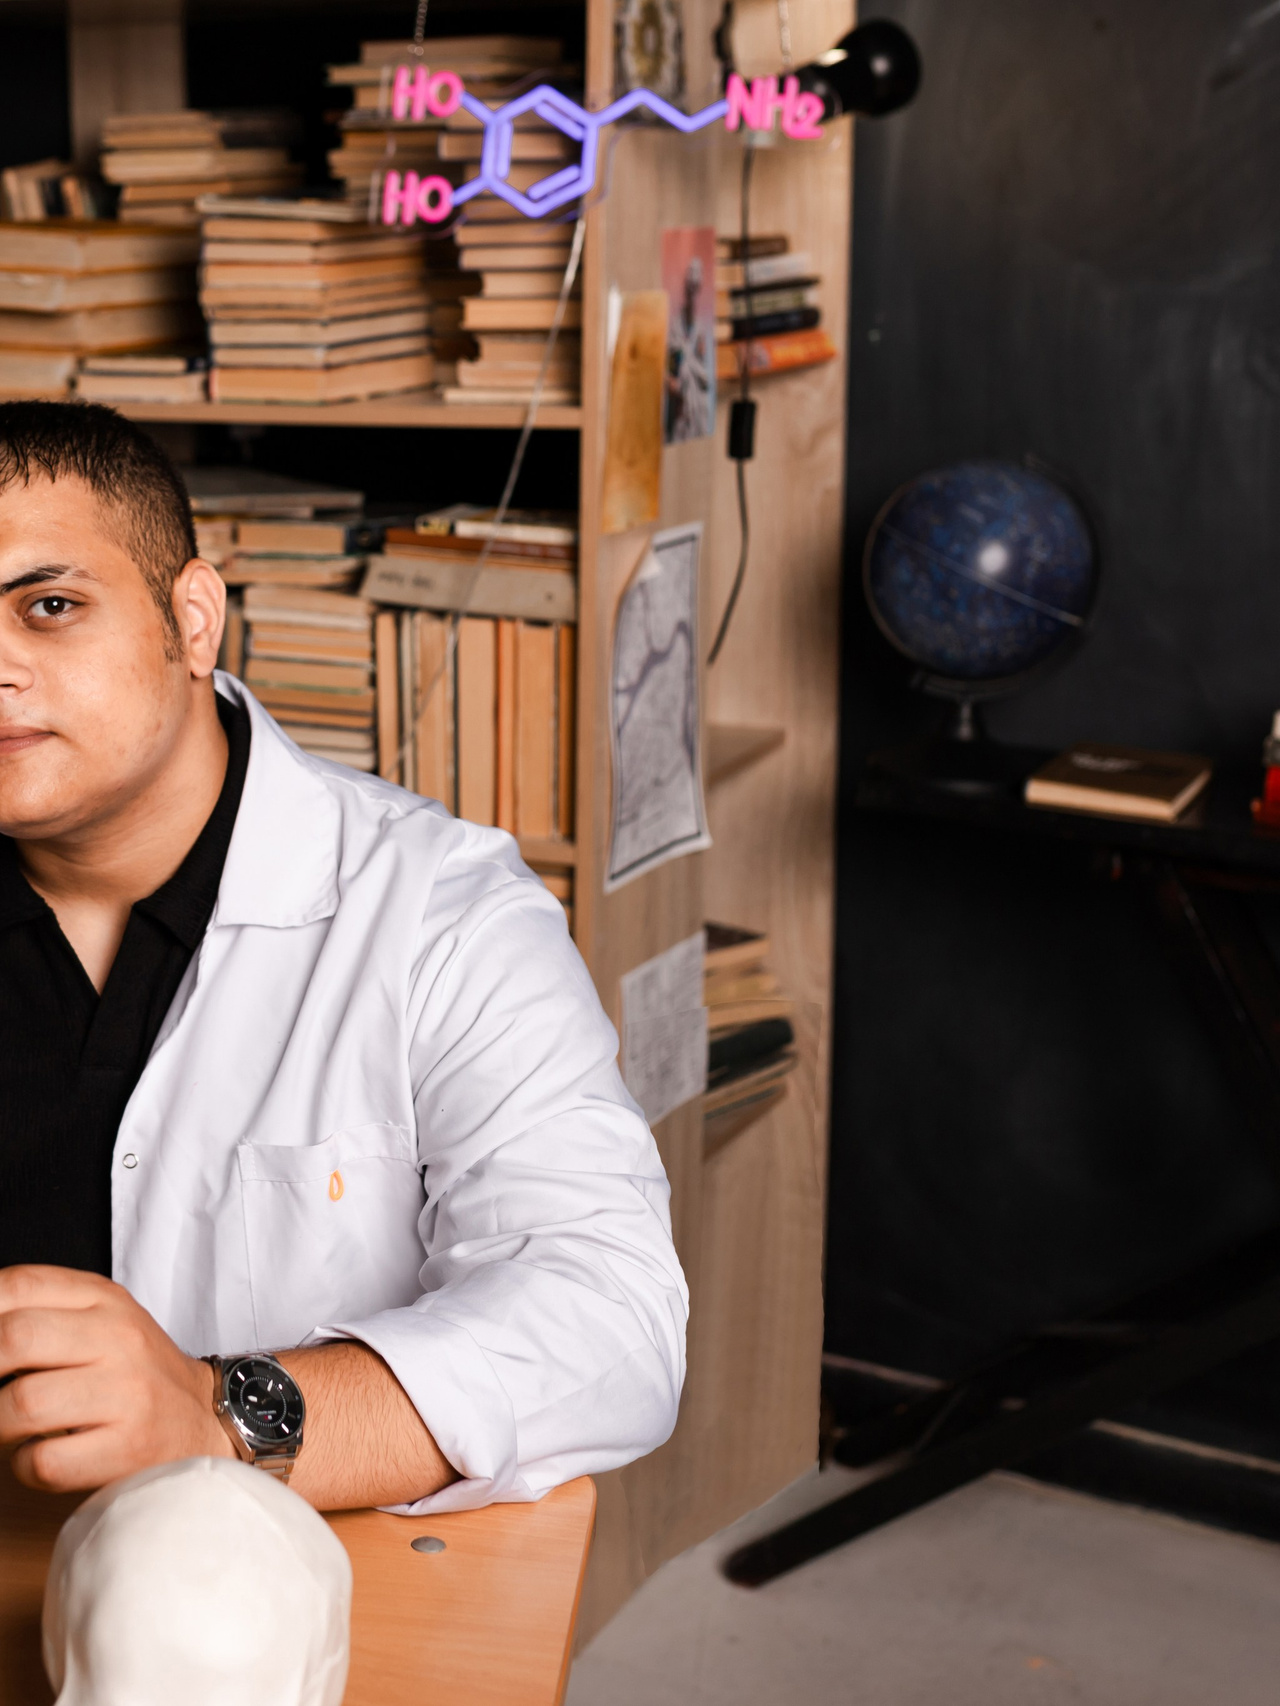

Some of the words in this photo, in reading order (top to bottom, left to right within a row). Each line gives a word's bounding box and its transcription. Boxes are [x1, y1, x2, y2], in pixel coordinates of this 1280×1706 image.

[393, 64, 464, 121] HO
[725, 72, 826, 139] NH2
[382, 170, 455, 226] HO
